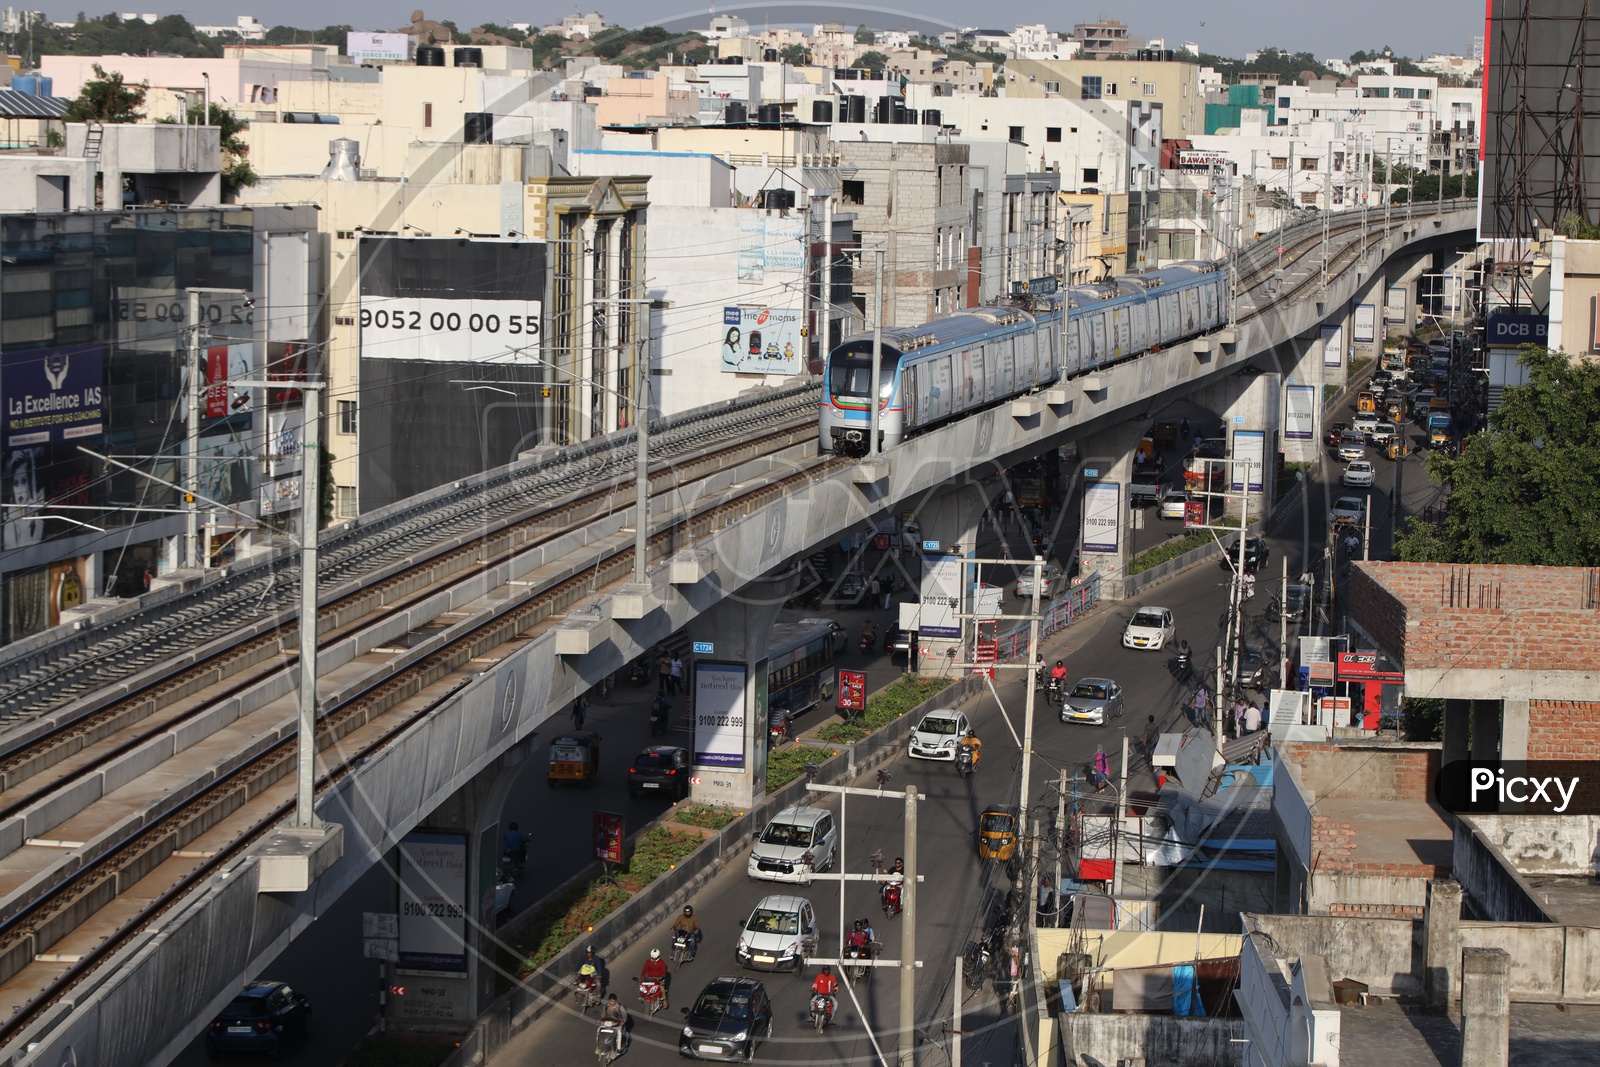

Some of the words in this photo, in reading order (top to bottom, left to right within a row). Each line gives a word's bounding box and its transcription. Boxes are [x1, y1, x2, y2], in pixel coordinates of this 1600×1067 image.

[361, 309, 421, 330] 9052
[430, 312, 461, 331] 00
[469, 313, 500, 333] 00
[508, 315, 540, 335] 55
[1497, 323, 1530, 335] DCB
[1536, 324, 1548, 336] B
[9, 397, 22, 415] La
[25, 392, 79, 414] Excellence
[84, 386, 102, 406] IAS
[24, 416, 51, 428] INSTITUTE
[52, 414, 63, 424] FOR
[64, 413, 74, 422] IAS
[74, 409, 101, 421] COACHING
[937, 596, 947, 605] 222
[699, 716, 715, 726] 9100
[717, 716, 729, 727] 222
[731, 717, 742, 727] 999
[420, 848, 434, 858] You
[436, 848, 456, 857] have
[404, 902, 425, 916] 9100
[428, 903, 444, 917] 222
[447, 904, 464, 918] 999
